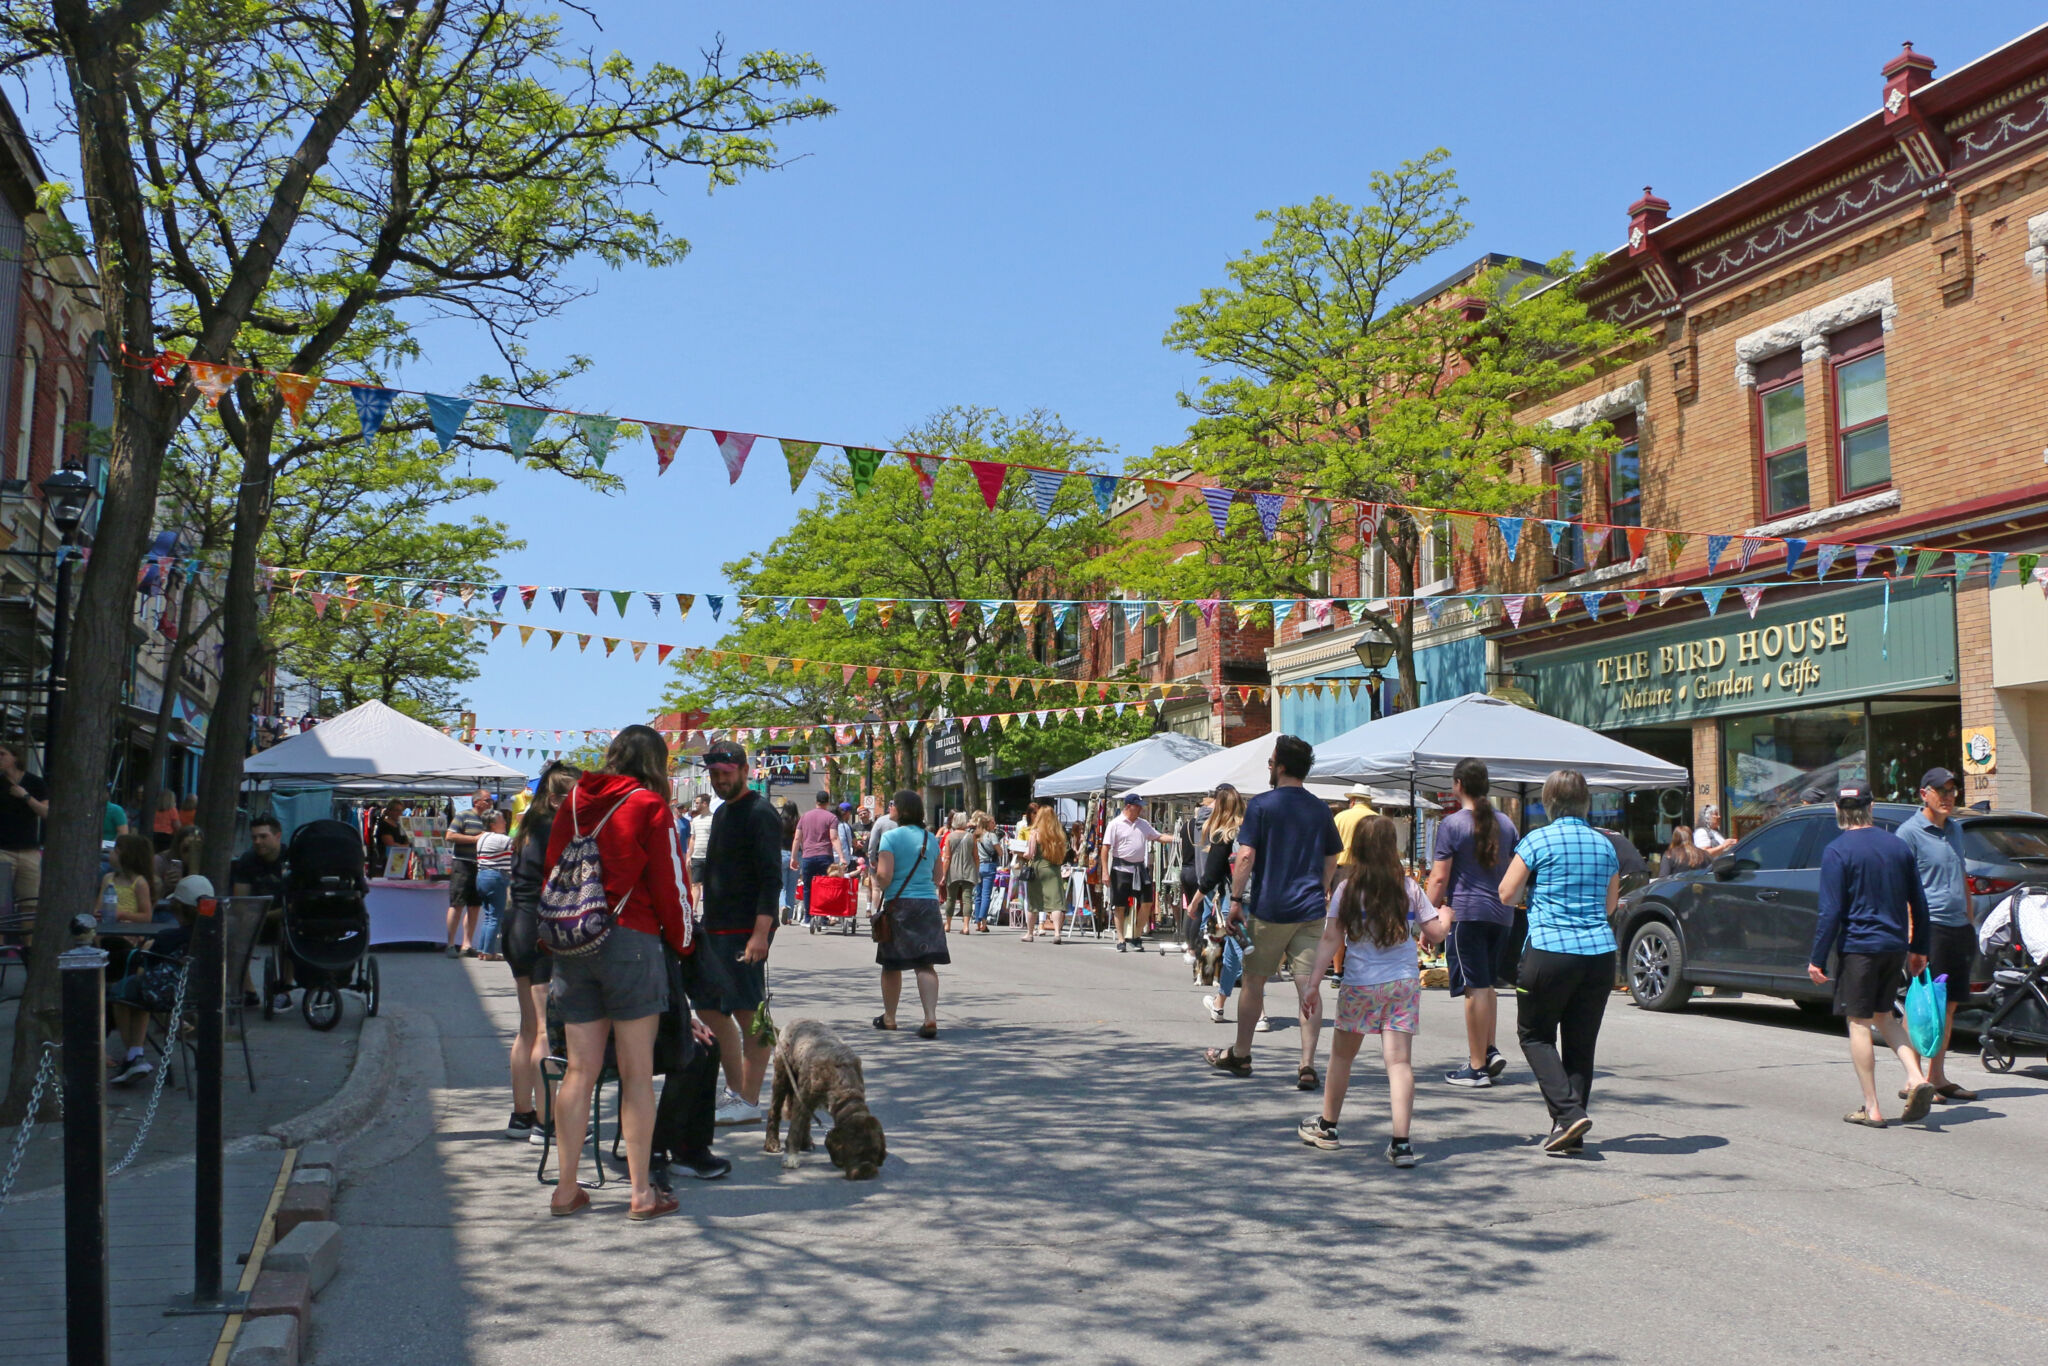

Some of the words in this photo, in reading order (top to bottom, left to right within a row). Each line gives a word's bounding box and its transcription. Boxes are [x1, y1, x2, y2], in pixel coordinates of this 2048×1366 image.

[1597, 651, 1650, 685] THE
[1658, 636, 1727, 675] BIRD
[1737, 612, 1849, 662] HOUSE
[1620, 686, 1672, 710] Nature
[1694, 669, 1754, 700] Garden
[1778, 656, 1821, 693] Gifts
[935, 739, 943, 749] THE
[944, 735, 956, 747] LUCKY
[1974, 776, 1989, 789] 110
